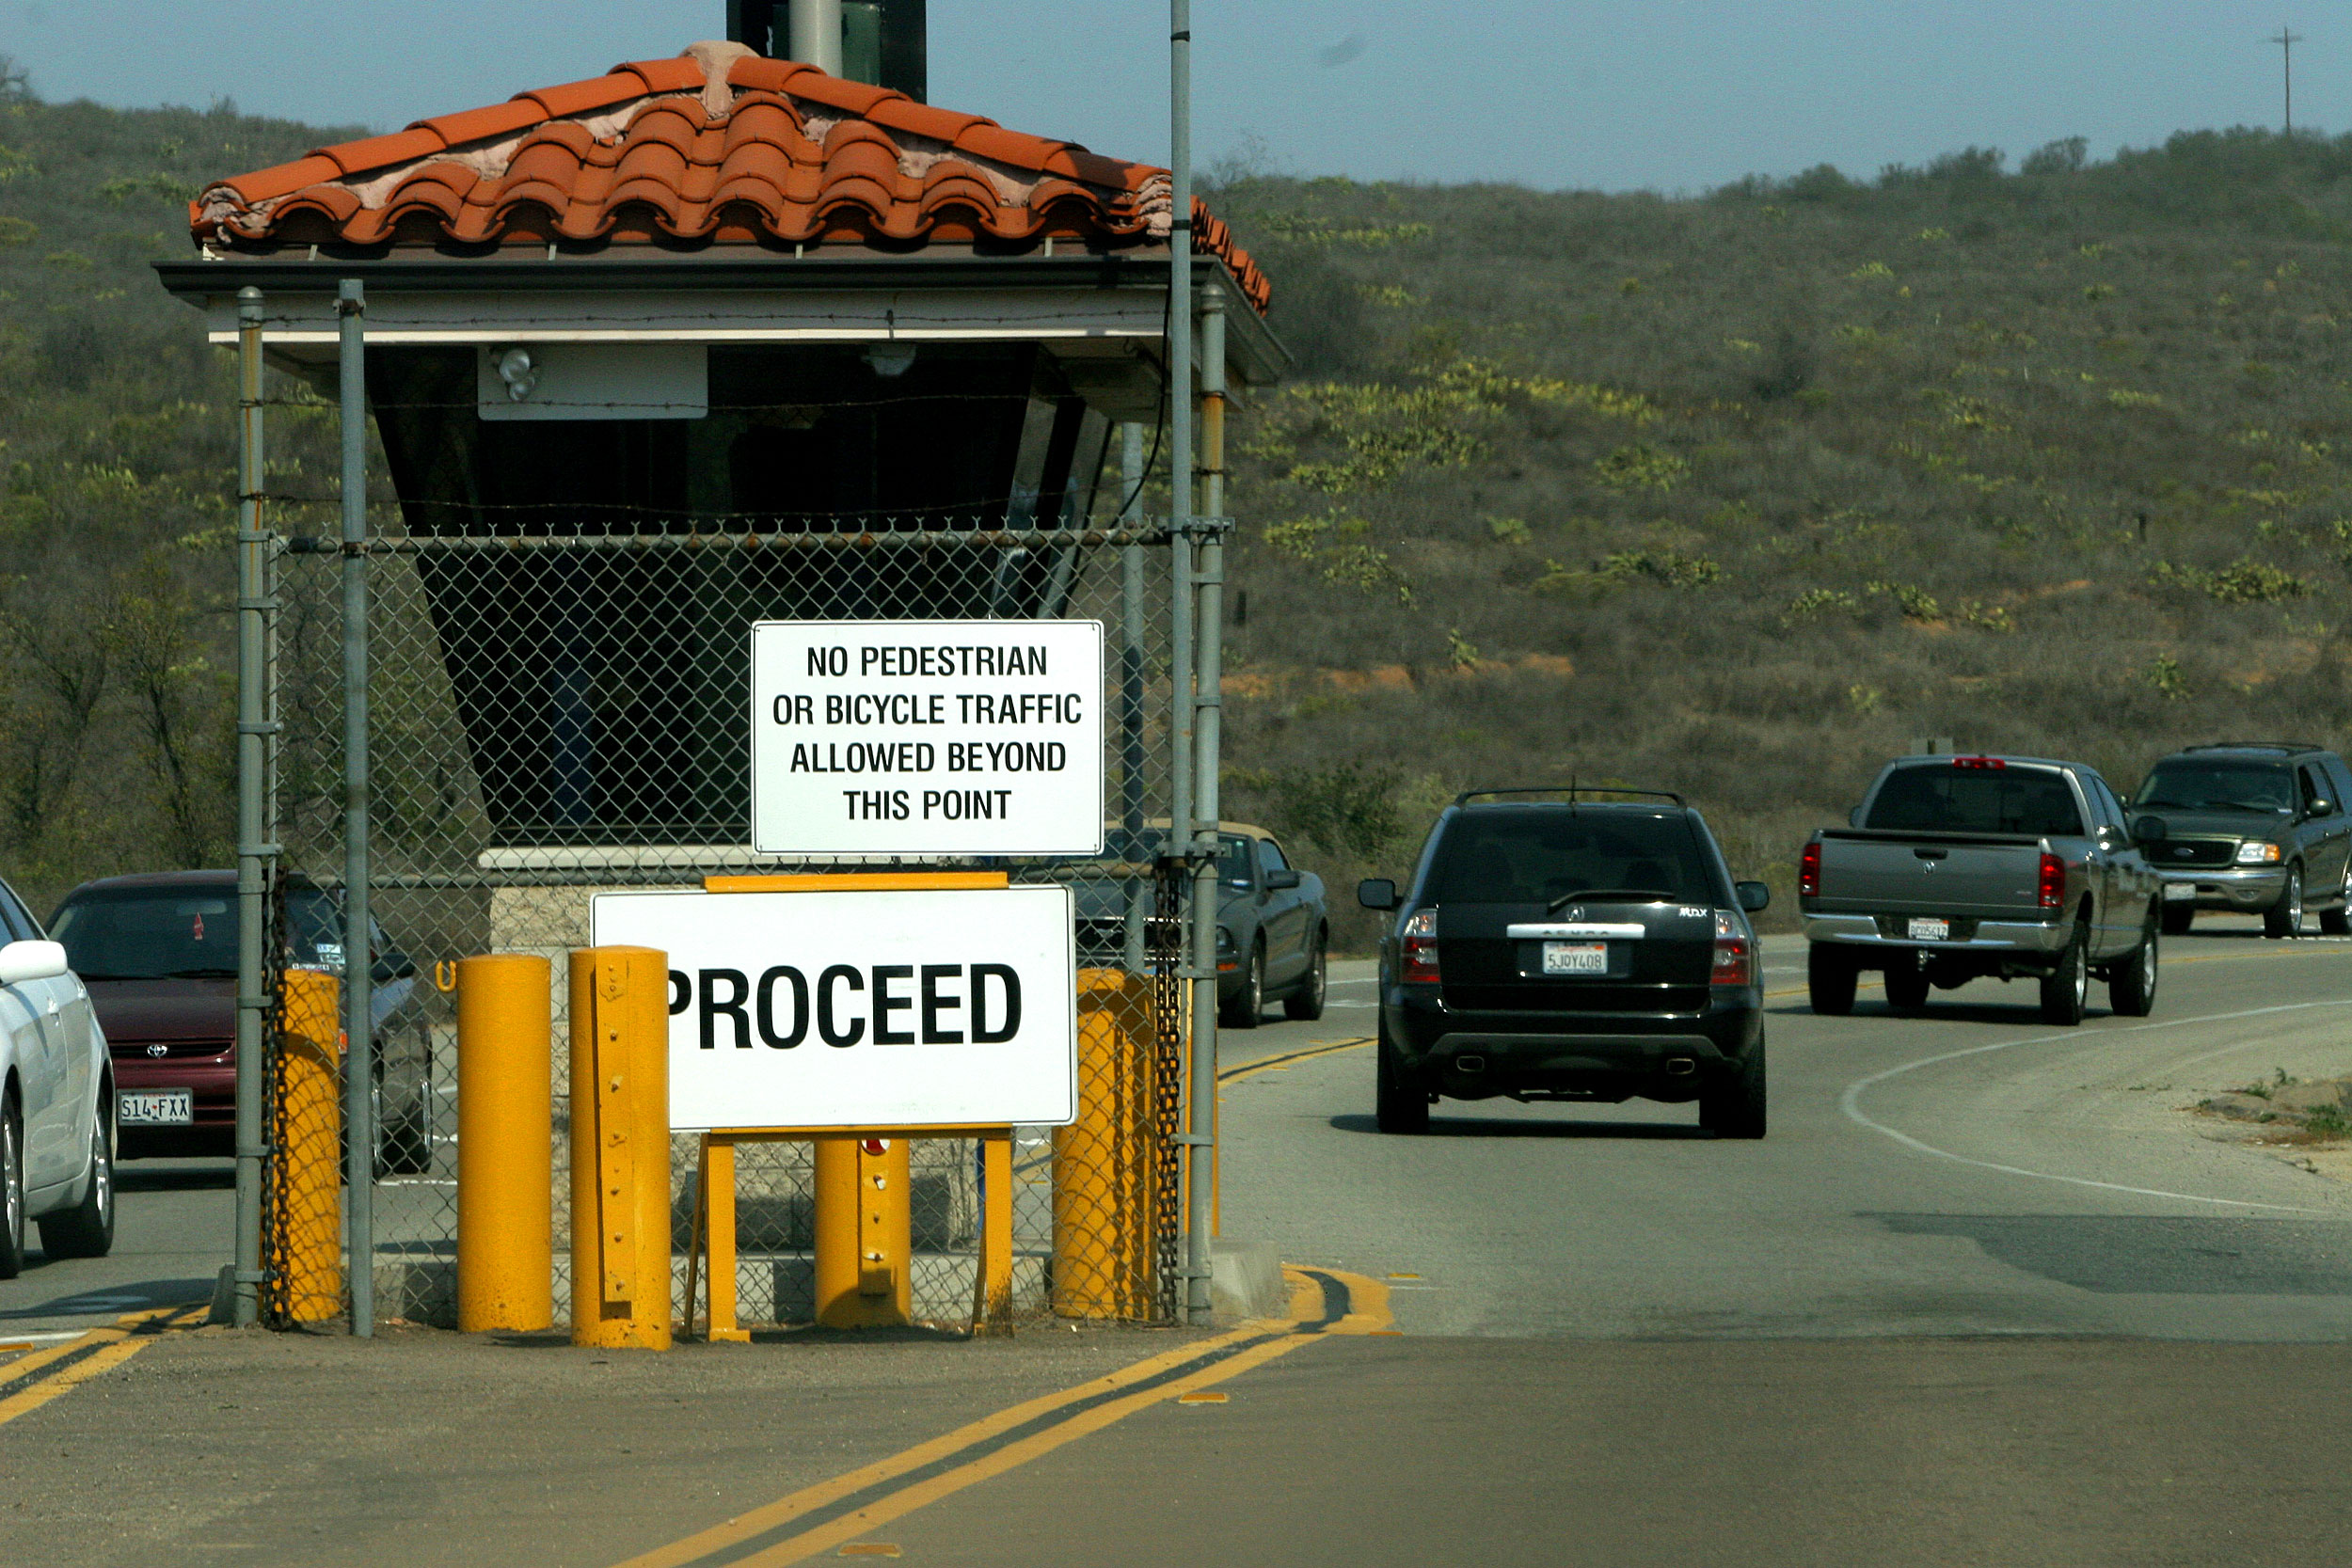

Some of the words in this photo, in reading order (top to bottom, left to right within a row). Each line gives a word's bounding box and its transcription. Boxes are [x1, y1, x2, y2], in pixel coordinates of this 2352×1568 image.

[808, 646, 848, 676] NO
[862, 646, 1047, 675] PEDESTRIAN
[773, 694, 814, 724] OR
[827, 694, 946, 724] BICYCLE
[956, 693, 1082, 723] TRAFFIC
[791, 742, 935, 772] ALLOWED
[948, 741, 1066, 771] BEYOND
[843, 790, 910, 819] THIS
[923, 790, 1012, 819] POINT
